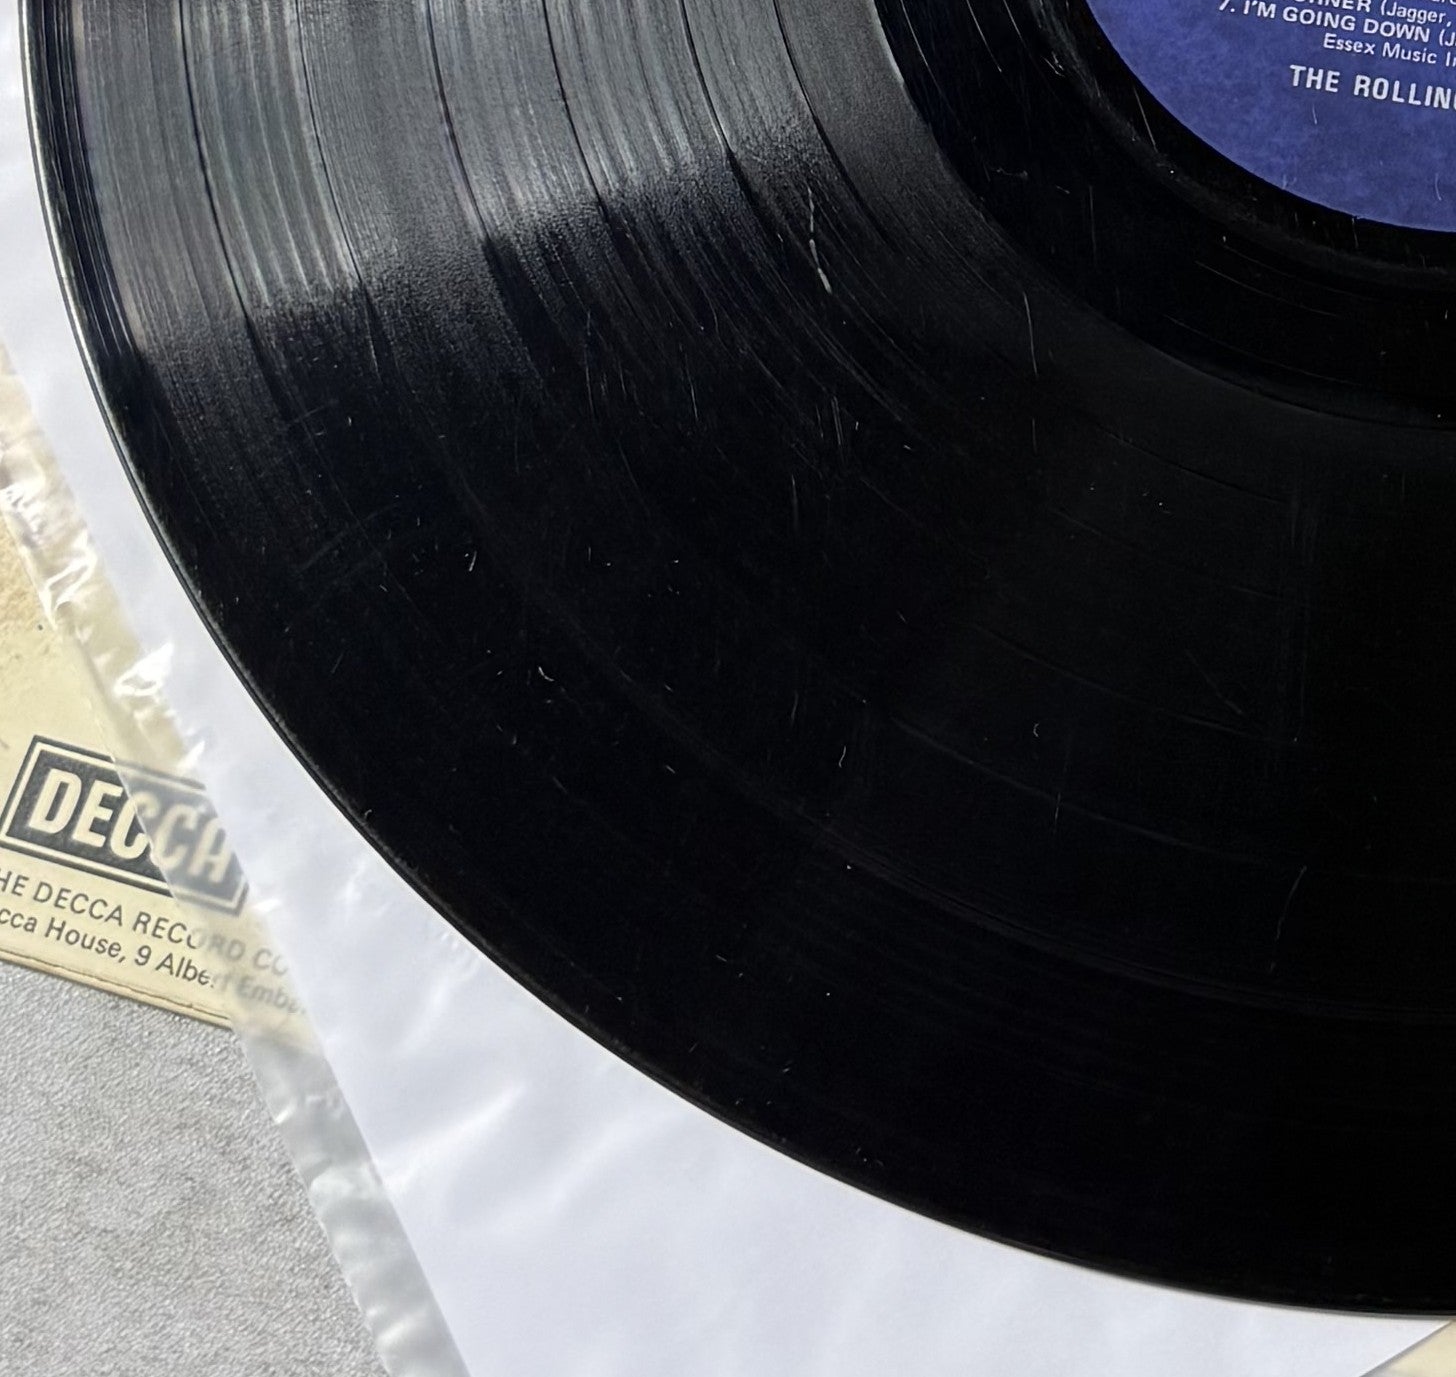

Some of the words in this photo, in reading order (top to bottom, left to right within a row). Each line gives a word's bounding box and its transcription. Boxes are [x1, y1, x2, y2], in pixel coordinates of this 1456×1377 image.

[1244, 0, 1276, 18] I'M
[1283, 7, 1355, 31] GOING
[1364, 19, 1430, 42] DOWN
[1323, 33, 1375, 54] Essex
[1383, 42, 1437, 64] Music
[1290, 65, 1340, 92] THE
[28, 767, 234, 885] DECCA
[33, 881, 124, 927] DECCA
[45, 917, 127, 964] House,
[134, 944, 151, 966] 9
